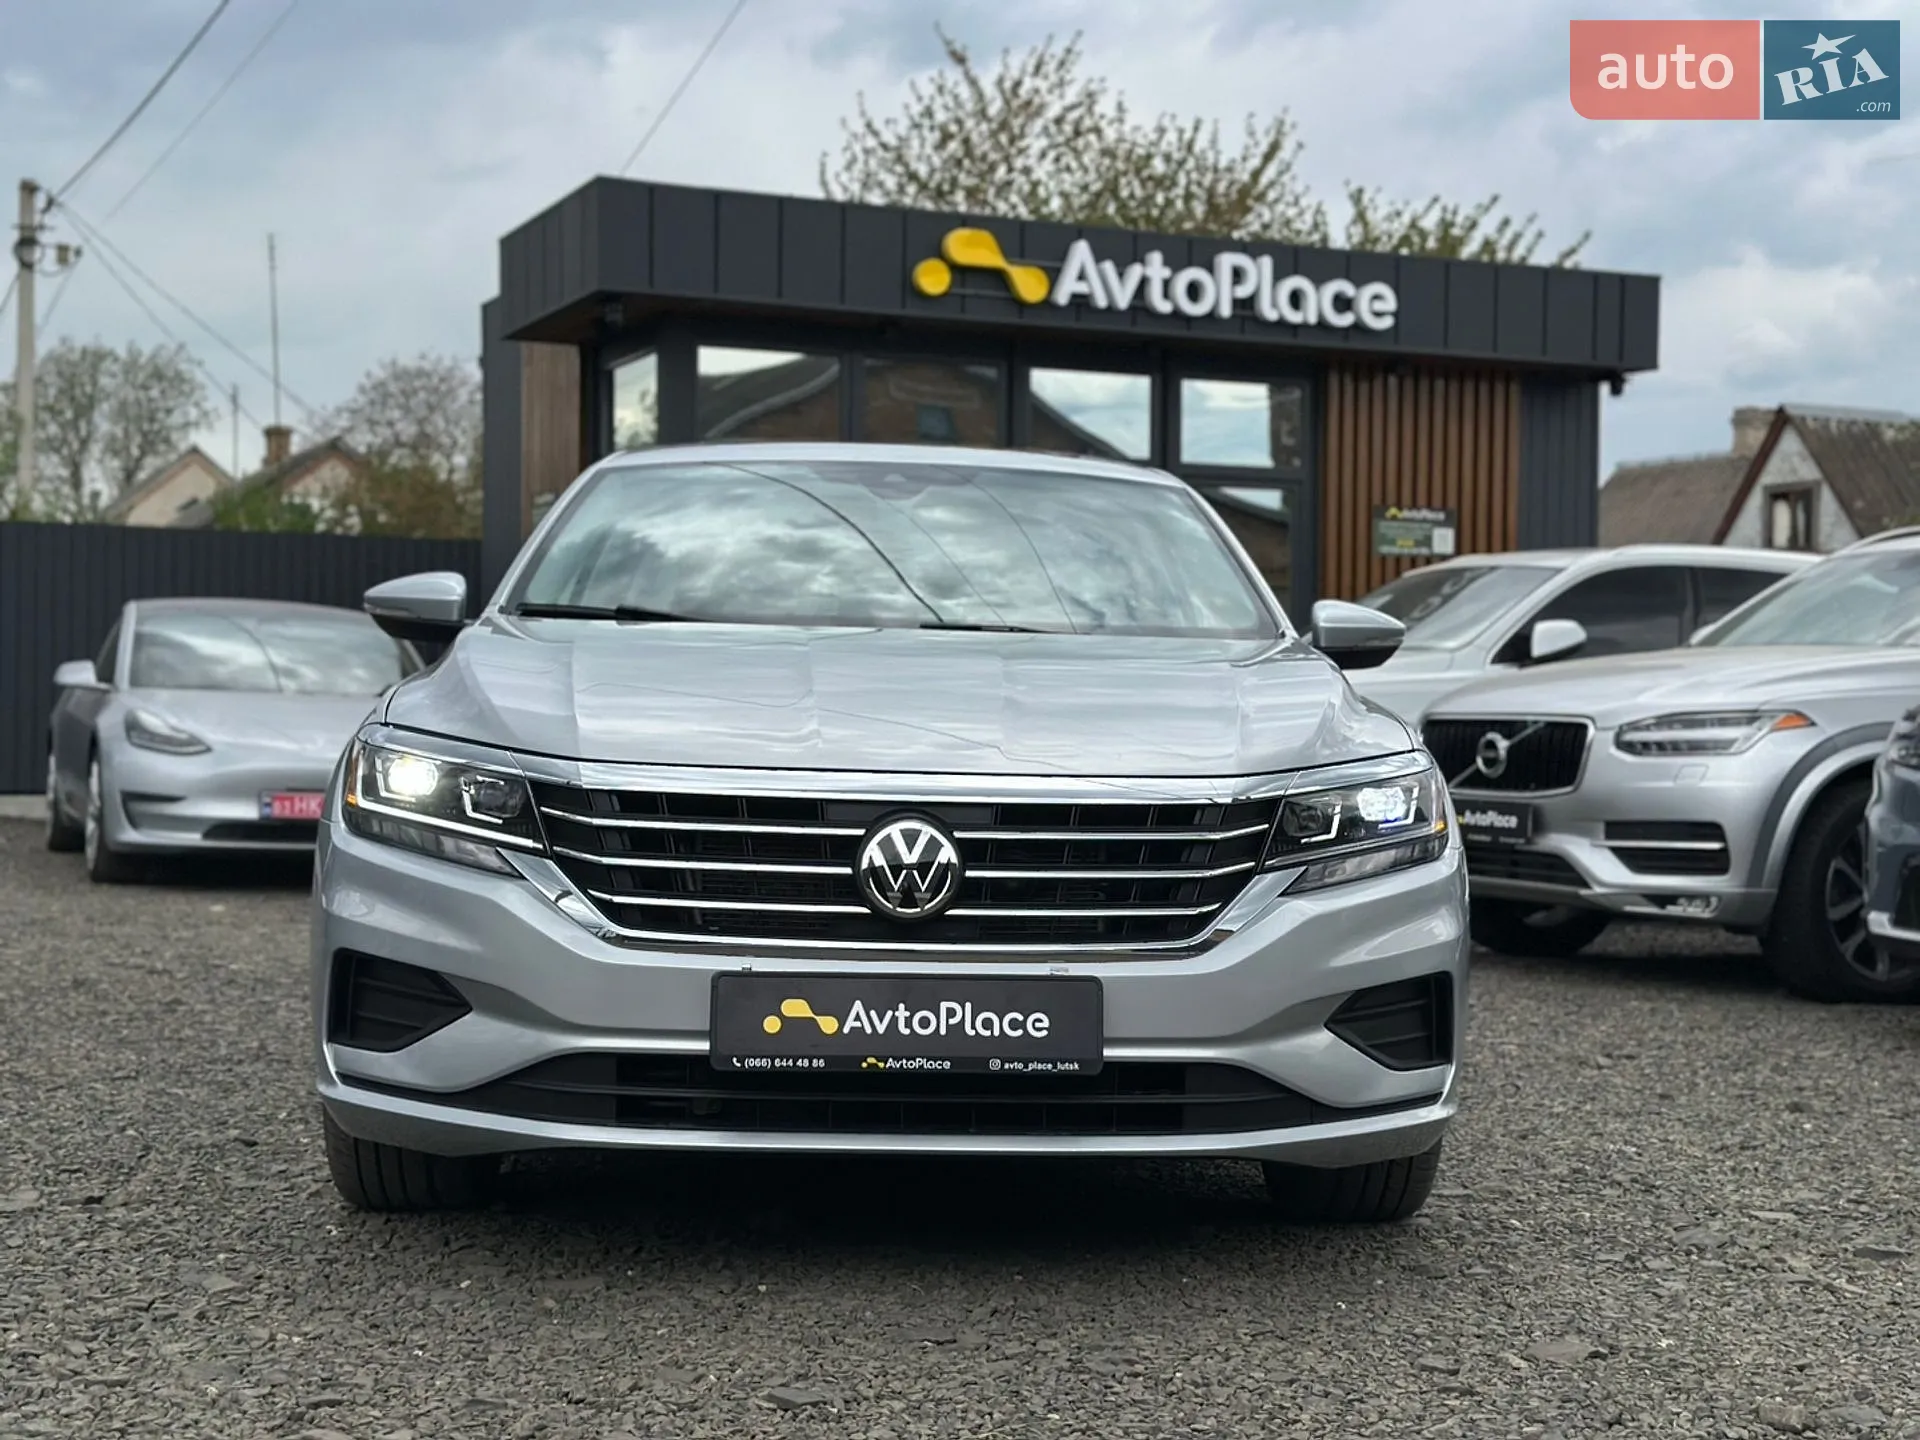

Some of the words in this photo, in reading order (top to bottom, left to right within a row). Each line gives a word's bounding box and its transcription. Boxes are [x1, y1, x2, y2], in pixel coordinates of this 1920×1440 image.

[1051, 238, 1398, 331] AvtoPlace
[1464, 809, 1518, 828] AvtoPlace
[842, 999, 1050, 1038] AvtoPlace
[886, 1057, 951, 1069] AvtoPlace
